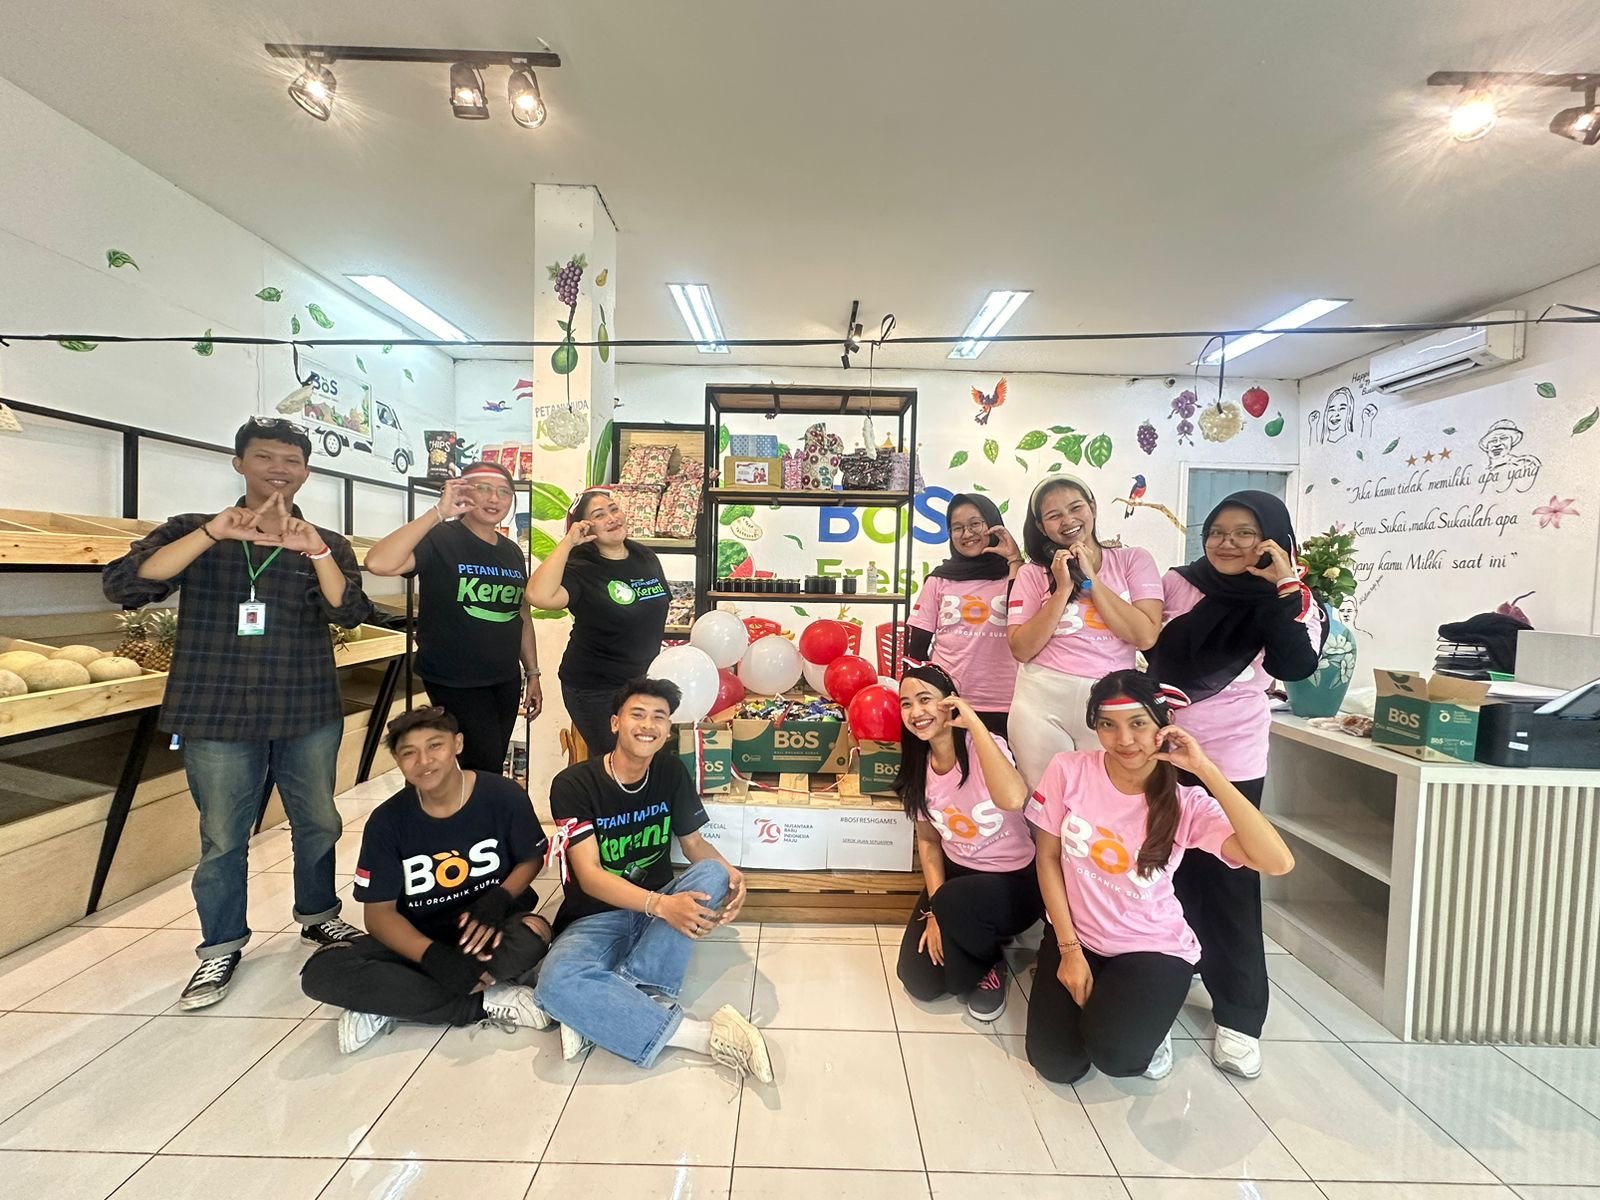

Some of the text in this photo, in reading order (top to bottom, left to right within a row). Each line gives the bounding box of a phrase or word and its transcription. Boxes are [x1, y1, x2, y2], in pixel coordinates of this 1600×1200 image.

[1374, 477, 1396, 497] kamu
[1397, 469, 1429, 495] tidak
[1428, 464, 1473, 490] memiliki
[1478, 469, 1500, 494] apa
[1496, 465, 1541, 494] yang
[1353, 520, 1377, 537] Kamu
[1437, 504, 1499, 529] Sukailah
[1495, 514, 1518, 537] apa
[458, 564, 499, 577] PETANI
[1377, 550, 1402, 571] kamu
[1451, 552, 1483, 569] saat
[426, 888, 470, 906] ORGANIK
[474, 878, 500, 892] SUBAK
[1076, 867, 1121, 893] ORGANIK
